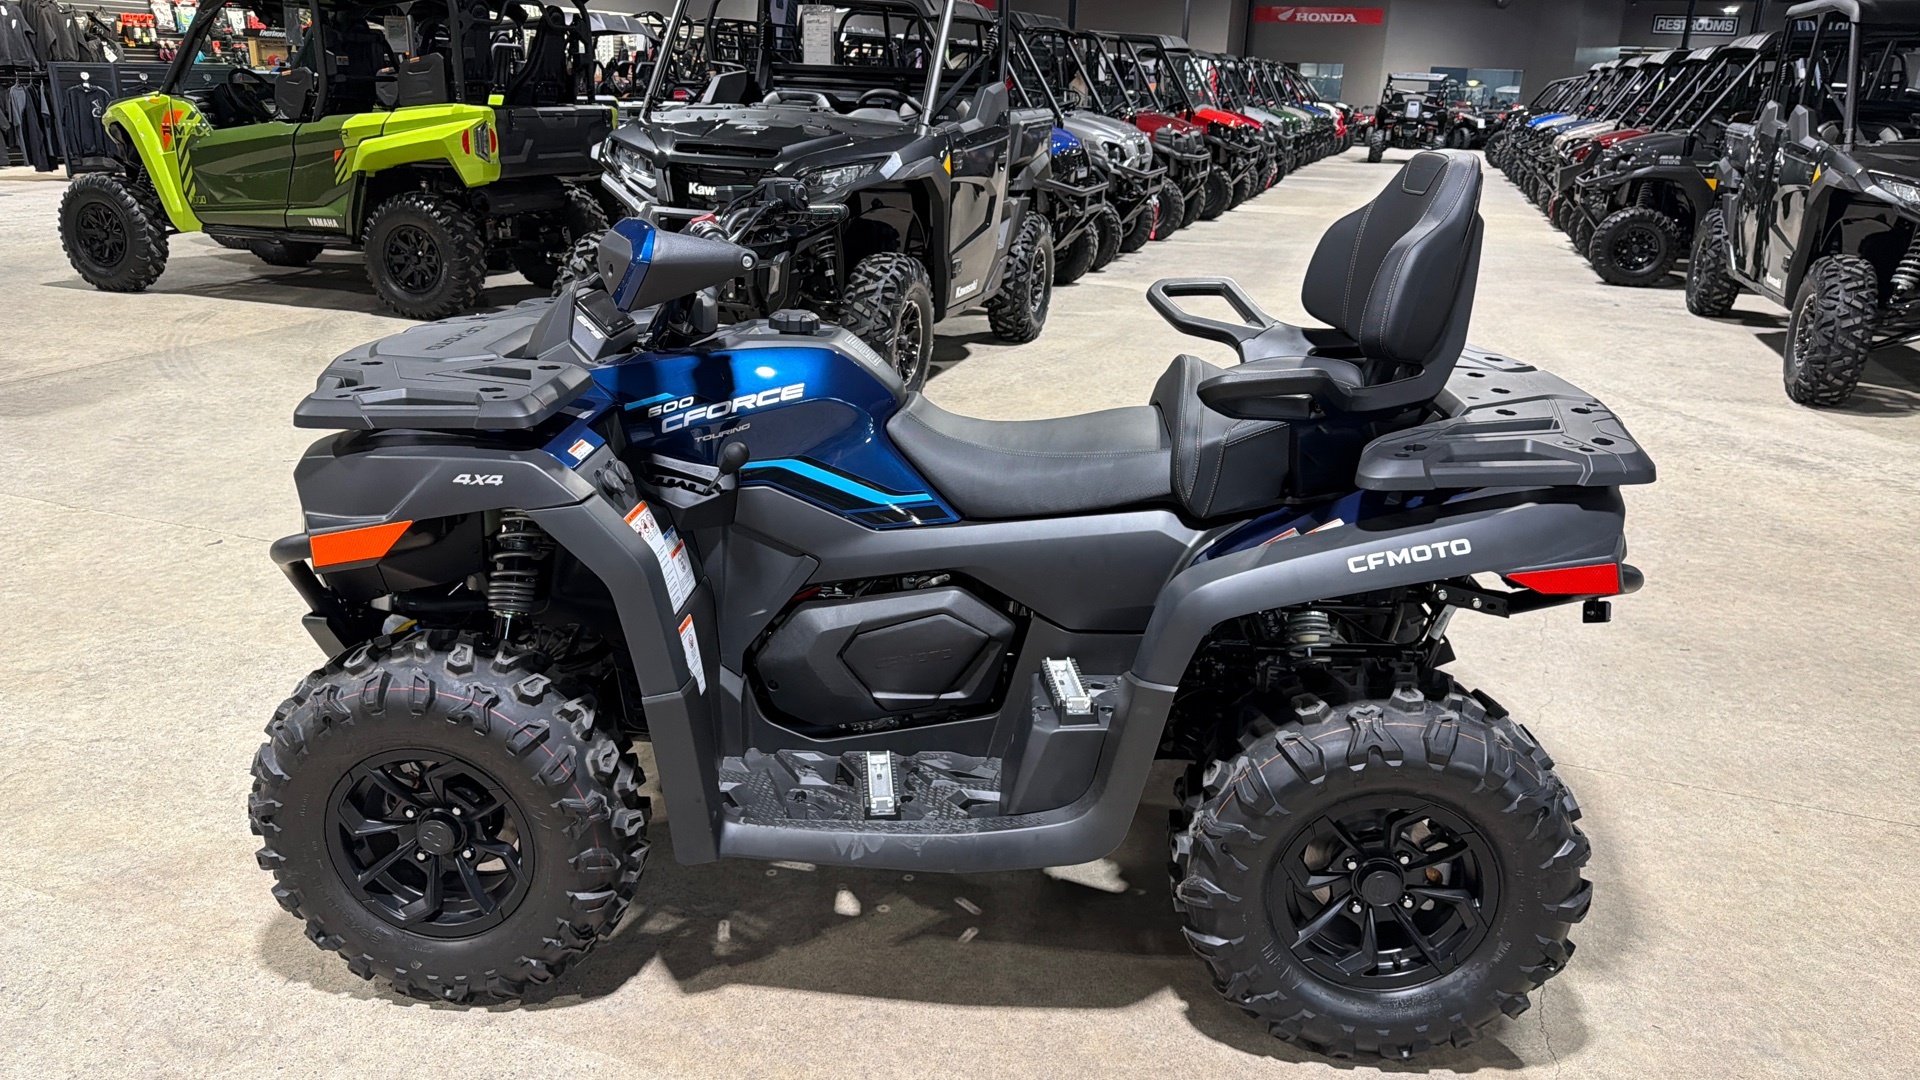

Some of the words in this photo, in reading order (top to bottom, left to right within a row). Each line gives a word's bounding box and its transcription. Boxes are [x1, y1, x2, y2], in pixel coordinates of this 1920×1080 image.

[1295, 12, 1357, 22] HONDA
[688, 182, 717, 196] Kaw
[307, 217, 339, 228] YAMAHA
[576, 315, 604, 340] EPS
[647, 396, 694, 418] 600
[661, 382, 805, 434] CFORCE
[694, 422, 751, 443] TOURING
[1346, 538, 1472, 574] CFMOTO
